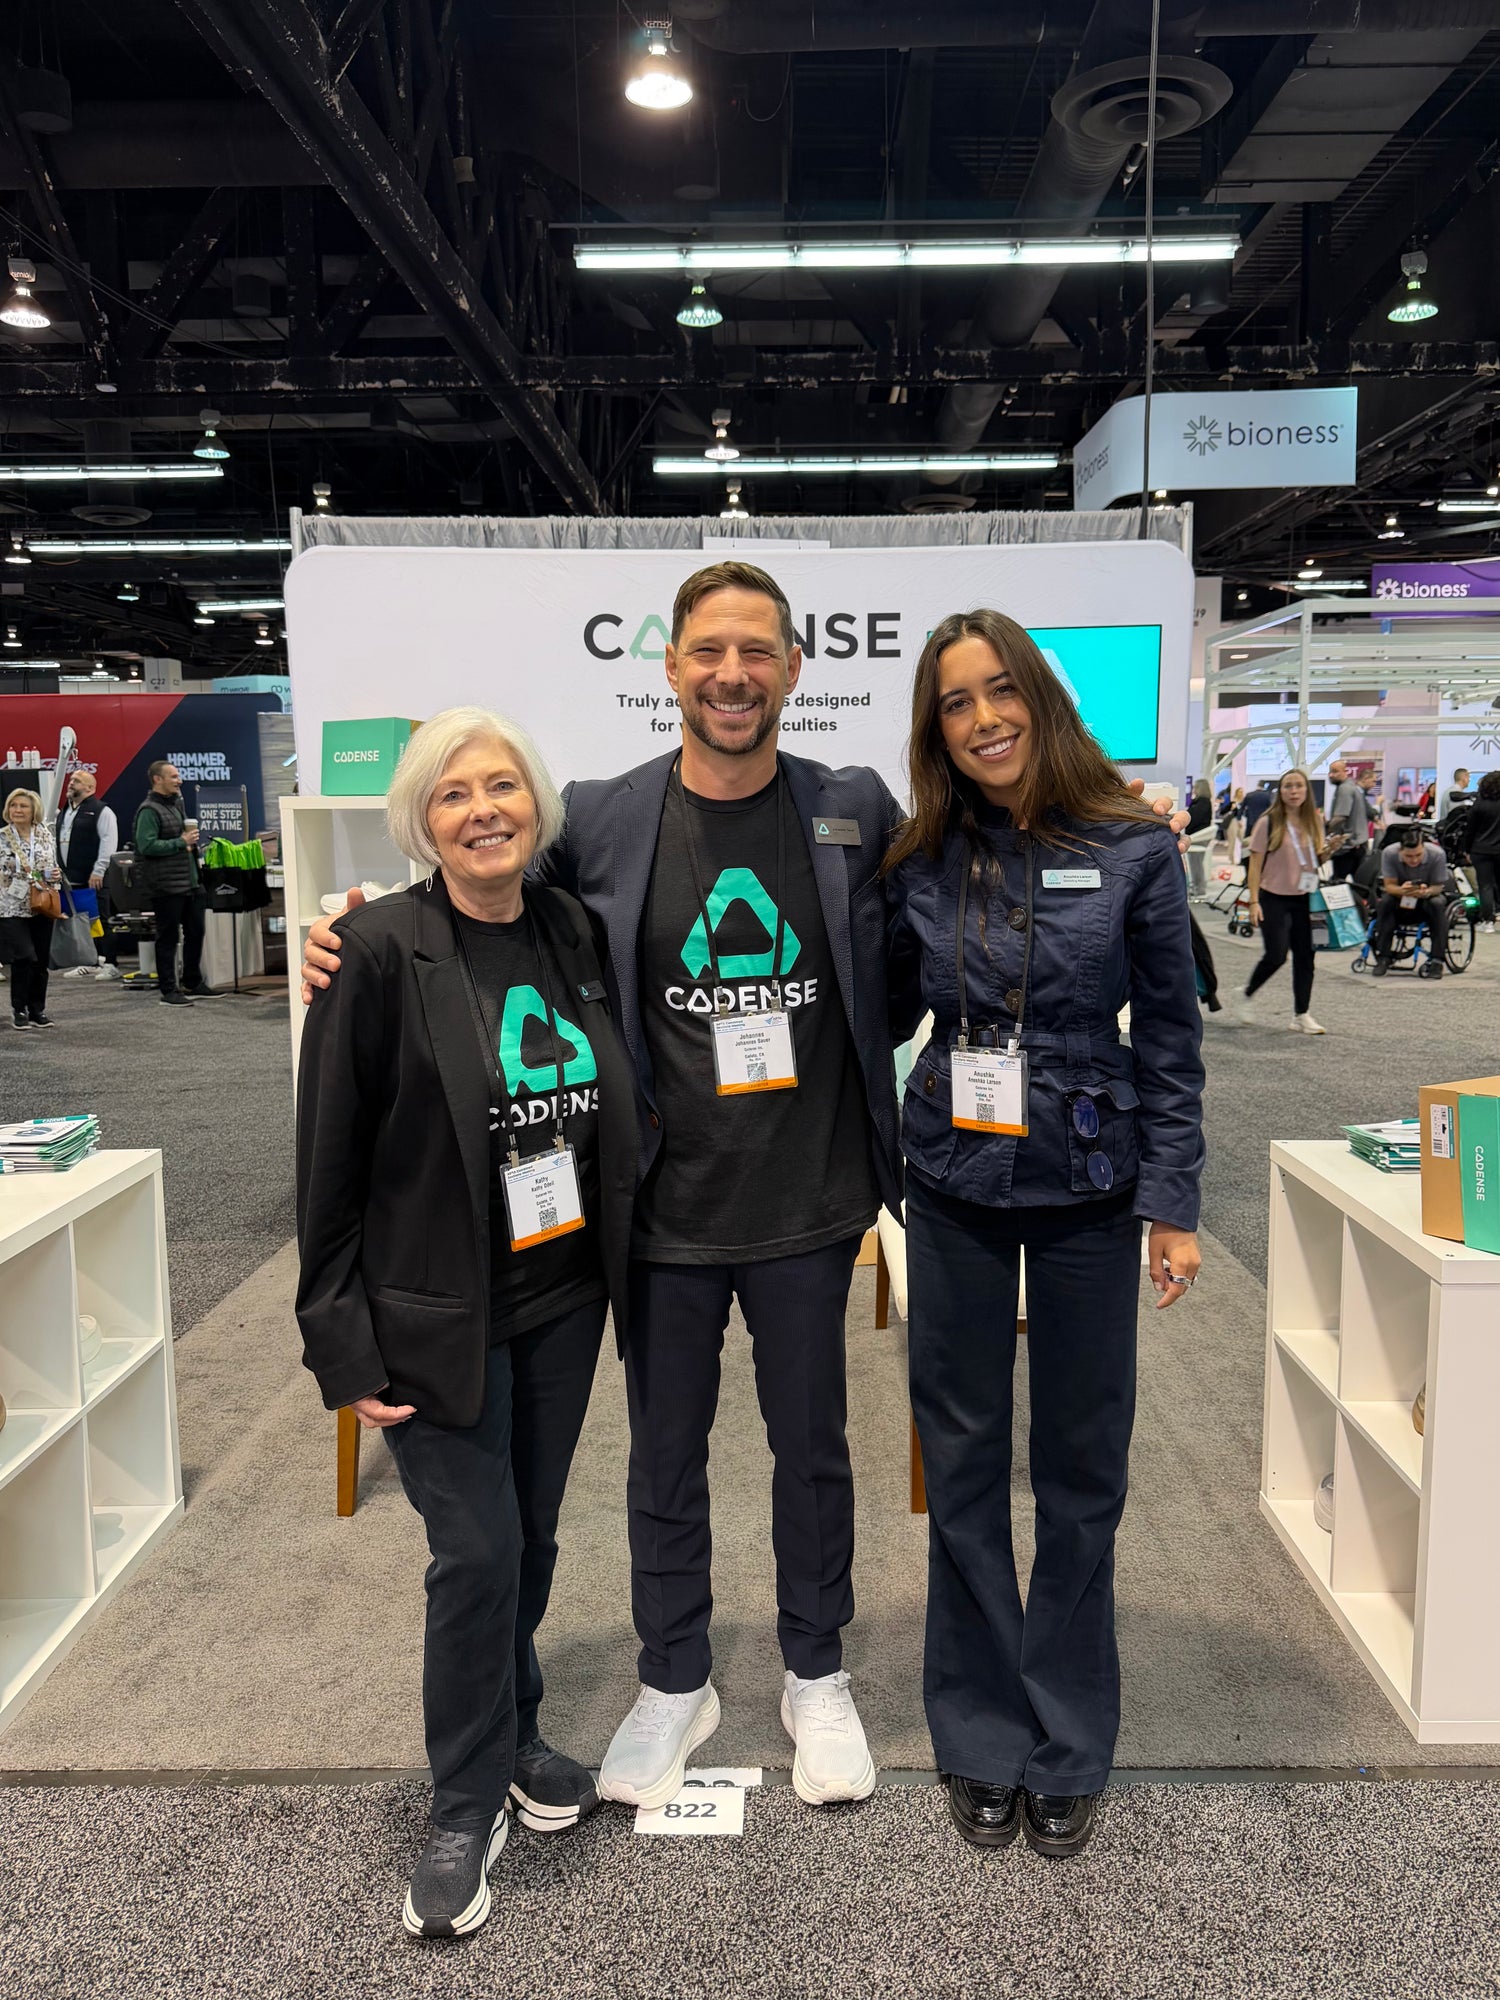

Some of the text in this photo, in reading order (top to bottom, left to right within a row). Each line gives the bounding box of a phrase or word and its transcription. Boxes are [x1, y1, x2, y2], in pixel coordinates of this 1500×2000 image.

[1228, 421, 1339, 446] bioness
[1401, 581, 1468, 598] bioness
[583, 612, 901, 660] CANSE
[616, 694, 660, 711] Truly
[795, 692, 870, 710] designed
[650, 718, 674, 732] for
[167, 752, 226, 767] HAMMER
[333, 750, 380, 763] CADENSE
[178, 766, 231, 781] RENGTH
[200, 809, 242, 819] ONE STEP
[200, 820, 243, 831] AT A TIME
[664, 978, 818, 1013] CADENSE
[1475, 1145, 1485, 1201] CADENSE
[664, 1803, 717, 1818] 822
